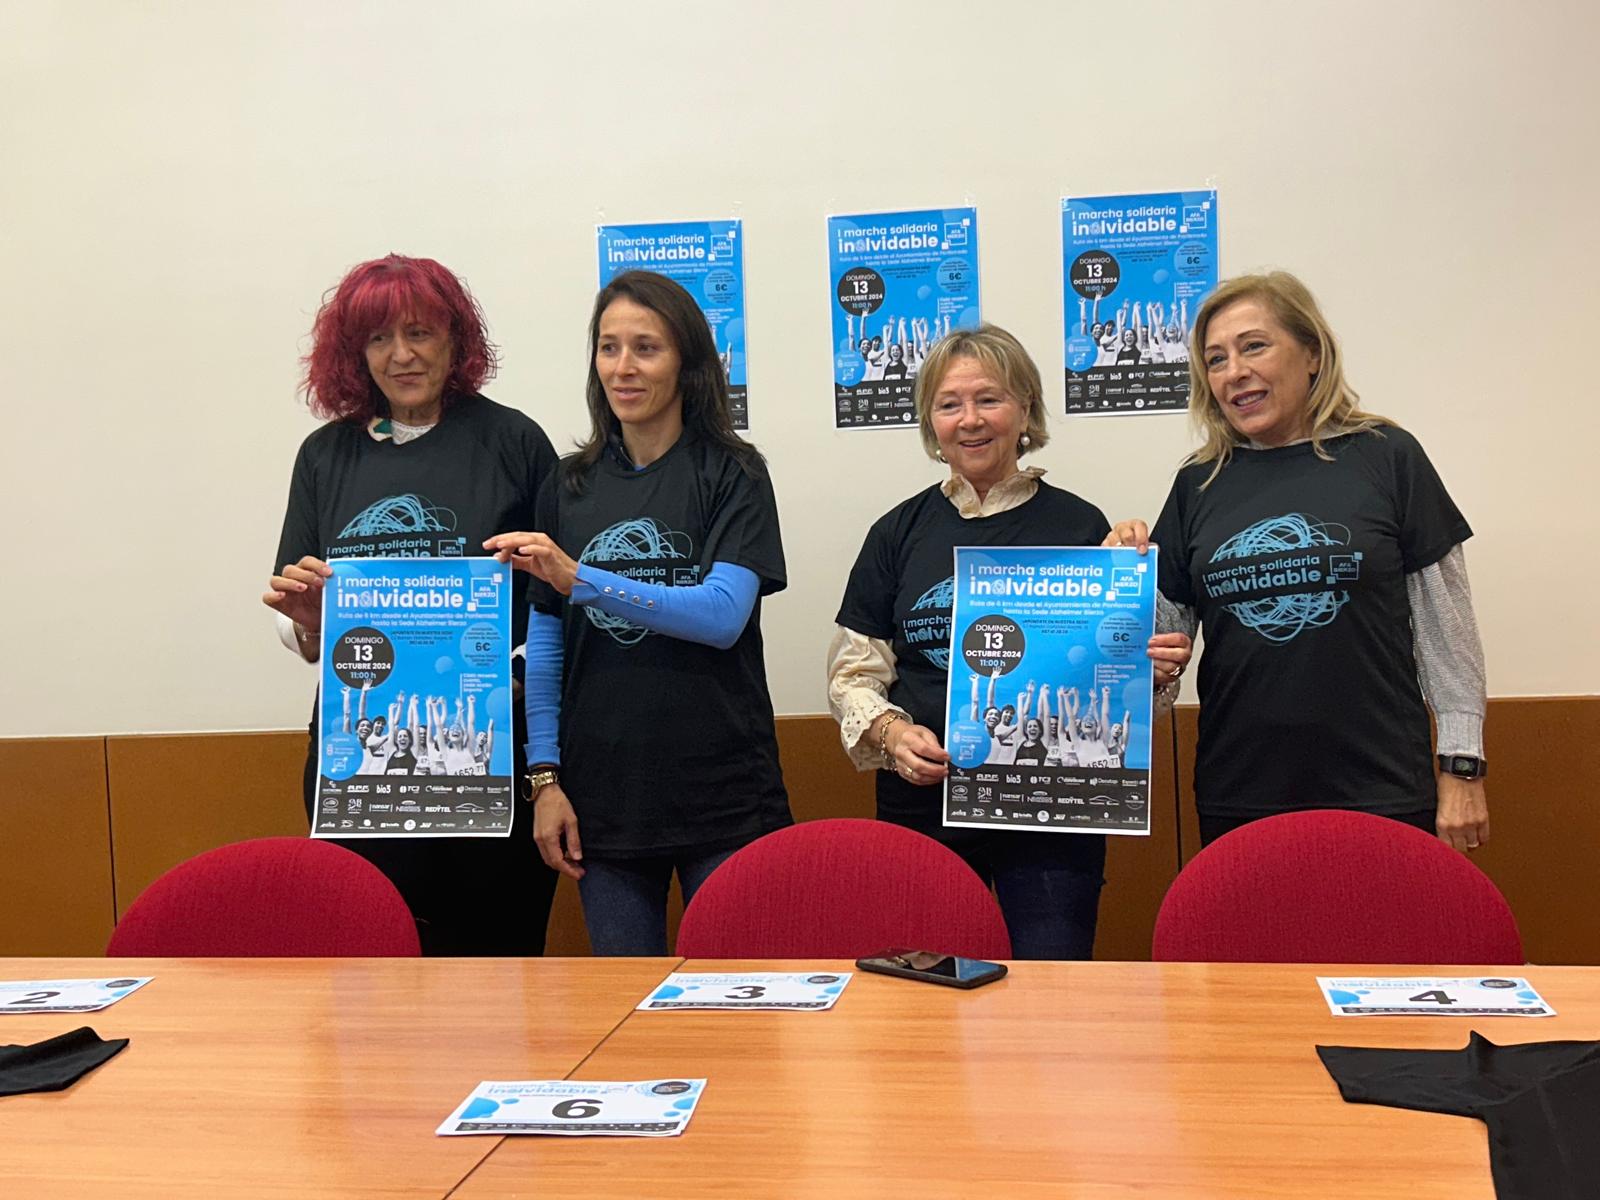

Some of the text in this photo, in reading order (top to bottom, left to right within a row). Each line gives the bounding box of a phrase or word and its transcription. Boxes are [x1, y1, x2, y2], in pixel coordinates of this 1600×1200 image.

[1079, 209, 1123, 220] marcha
[1127, 206, 1176, 216] solidaria
[844, 226, 887, 237] marcha
[890, 223, 938, 234] solidaria
[1072, 217, 1176, 236] inolvidable
[614, 236, 655, 246] marcha
[658, 234, 704, 245] solidaria
[838, 234, 938, 254] inolvidable
[608, 246, 706, 262] inolvidable
[1080, 257, 1110, 265] DOMINGO
[1187, 257, 1200, 265] 6€
[1086, 264, 1102, 278] 13
[846, 274, 876, 282] DOMINGO
[1102, 276, 1118, 284] 2024
[715, 284, 728, 292] 6€
[852, 281, 868, 294] 13
[840, 294, 867, 302] OCTUBRE
[332, 544, 375, 554] marcha
[378, 538, 432, 550] solidaria
[616, 566, 666, 578] solidaria
[978, 564, 1035, 576] marcha
[1040, 564, 1104, 577] solidaria
[1208, 564, 1256, 582] marcha
[1260, 555, 1320, 572] solidaria
[346, 576, 400, 588] marcha
[404, 575, 463, 588] solidaria
[970, 576, 1103, 597] inolvidable
[1206, 568, 1322, 598] inolvidable
[338, 589, 464, 608] inolvidable
[908, 615, 952, 628] marcha
[976, 624, 1015, 632] DOMINGO
[984, 632, 1004, 650] 13
[1112, 632, 1130, 642] 6€
[353, 644, 373, 662] 13
[475, 642, 491, 652] 6€
[1002, 650, 1022, 658] 2024
[1006, 774, 1022, 784] bio3
[376, 784, 392, 794] bio3
[8, 992, 61, 1004] 2
[724, 986, 766, 1000] 3
[1408, 990, 1458, 1004] 4
[552, 1098, 604, 1119] 6
